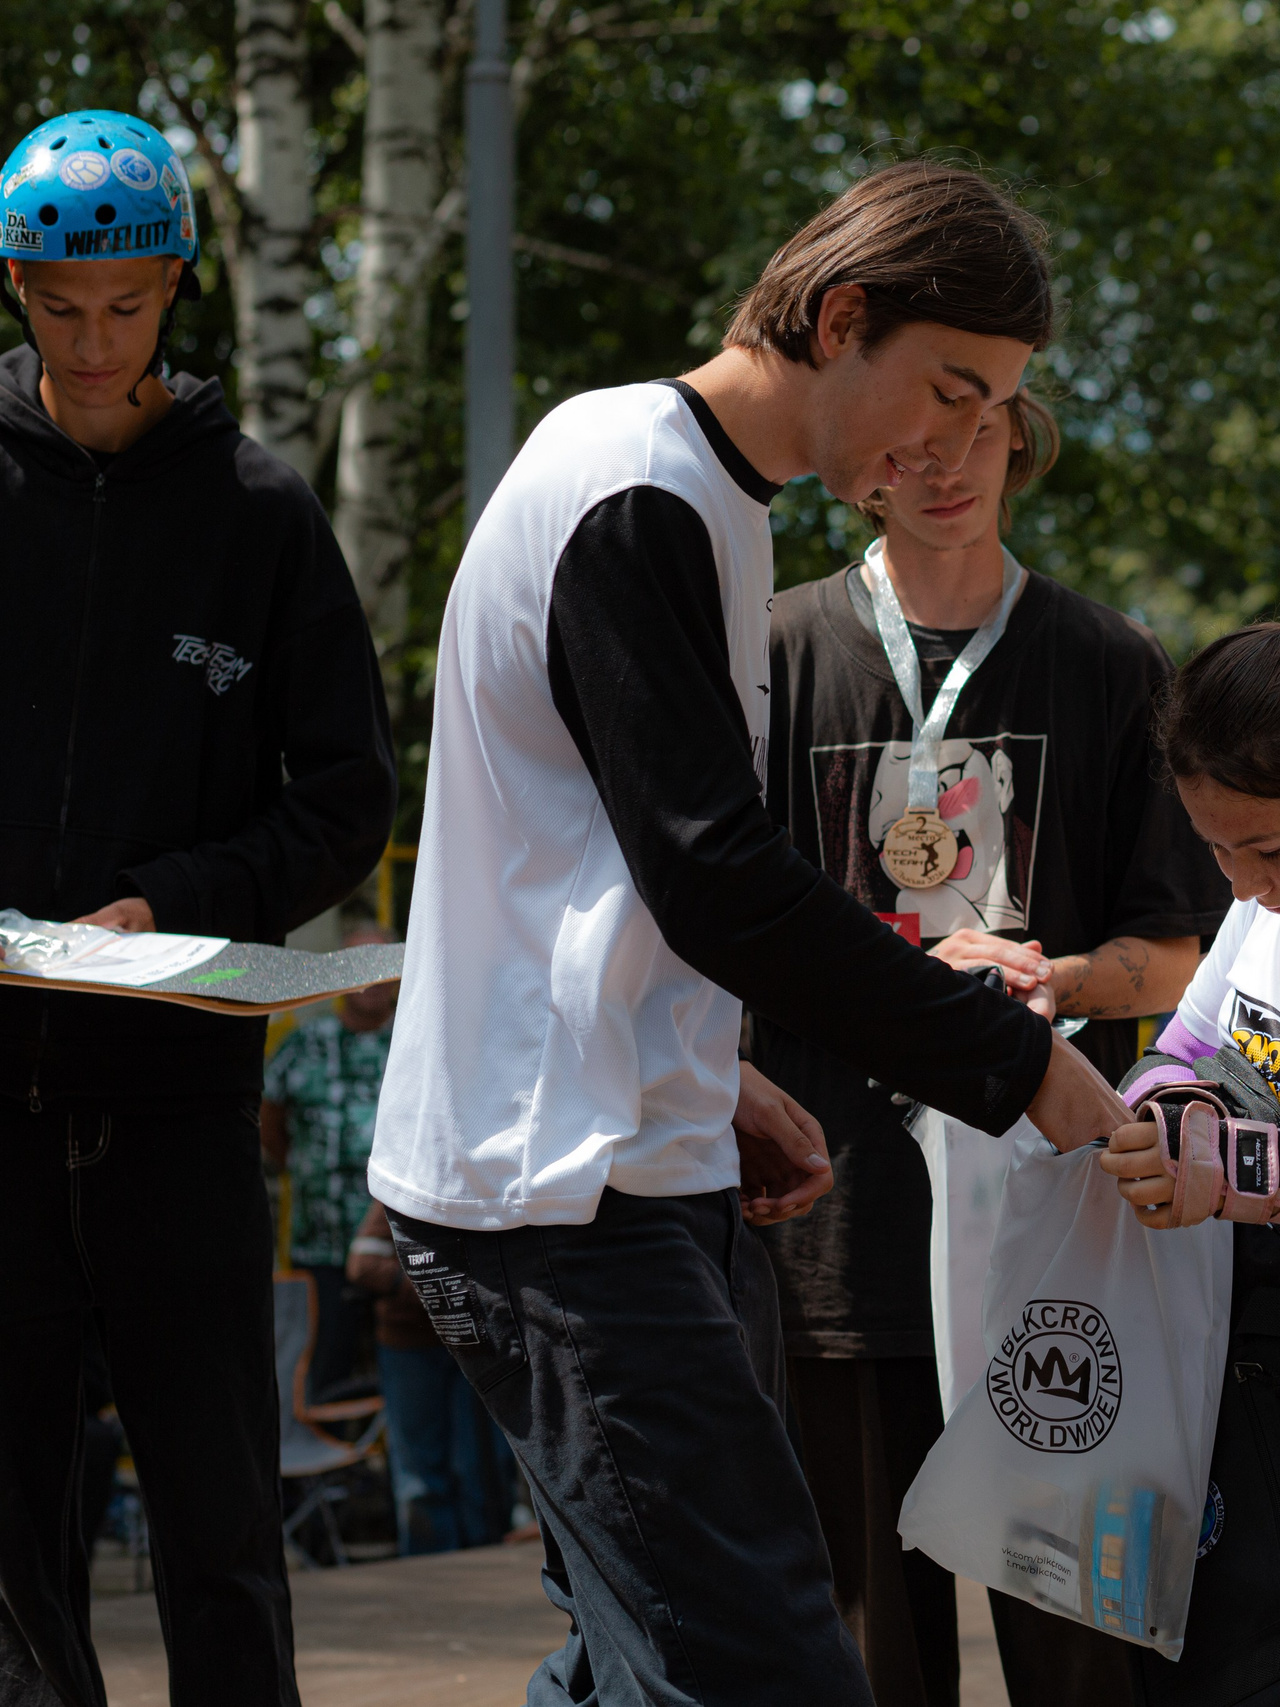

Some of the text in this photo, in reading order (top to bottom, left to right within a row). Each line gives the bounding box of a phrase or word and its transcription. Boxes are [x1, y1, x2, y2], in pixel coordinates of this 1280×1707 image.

[8, 213, 26, 228] DA
[65, 220, 171, 257] WHEELCITY
[916, 816, 927, 834] 2
[1001, 1305, 1118, 1384] BLKCROWN
[990, 1370, 1115, 1448] WORLDWIDE
[1002, 1547, 1072, 1577] vk.com/blkcrown
[1007, 1560, 1067, 1586] t.me/blkcrown
